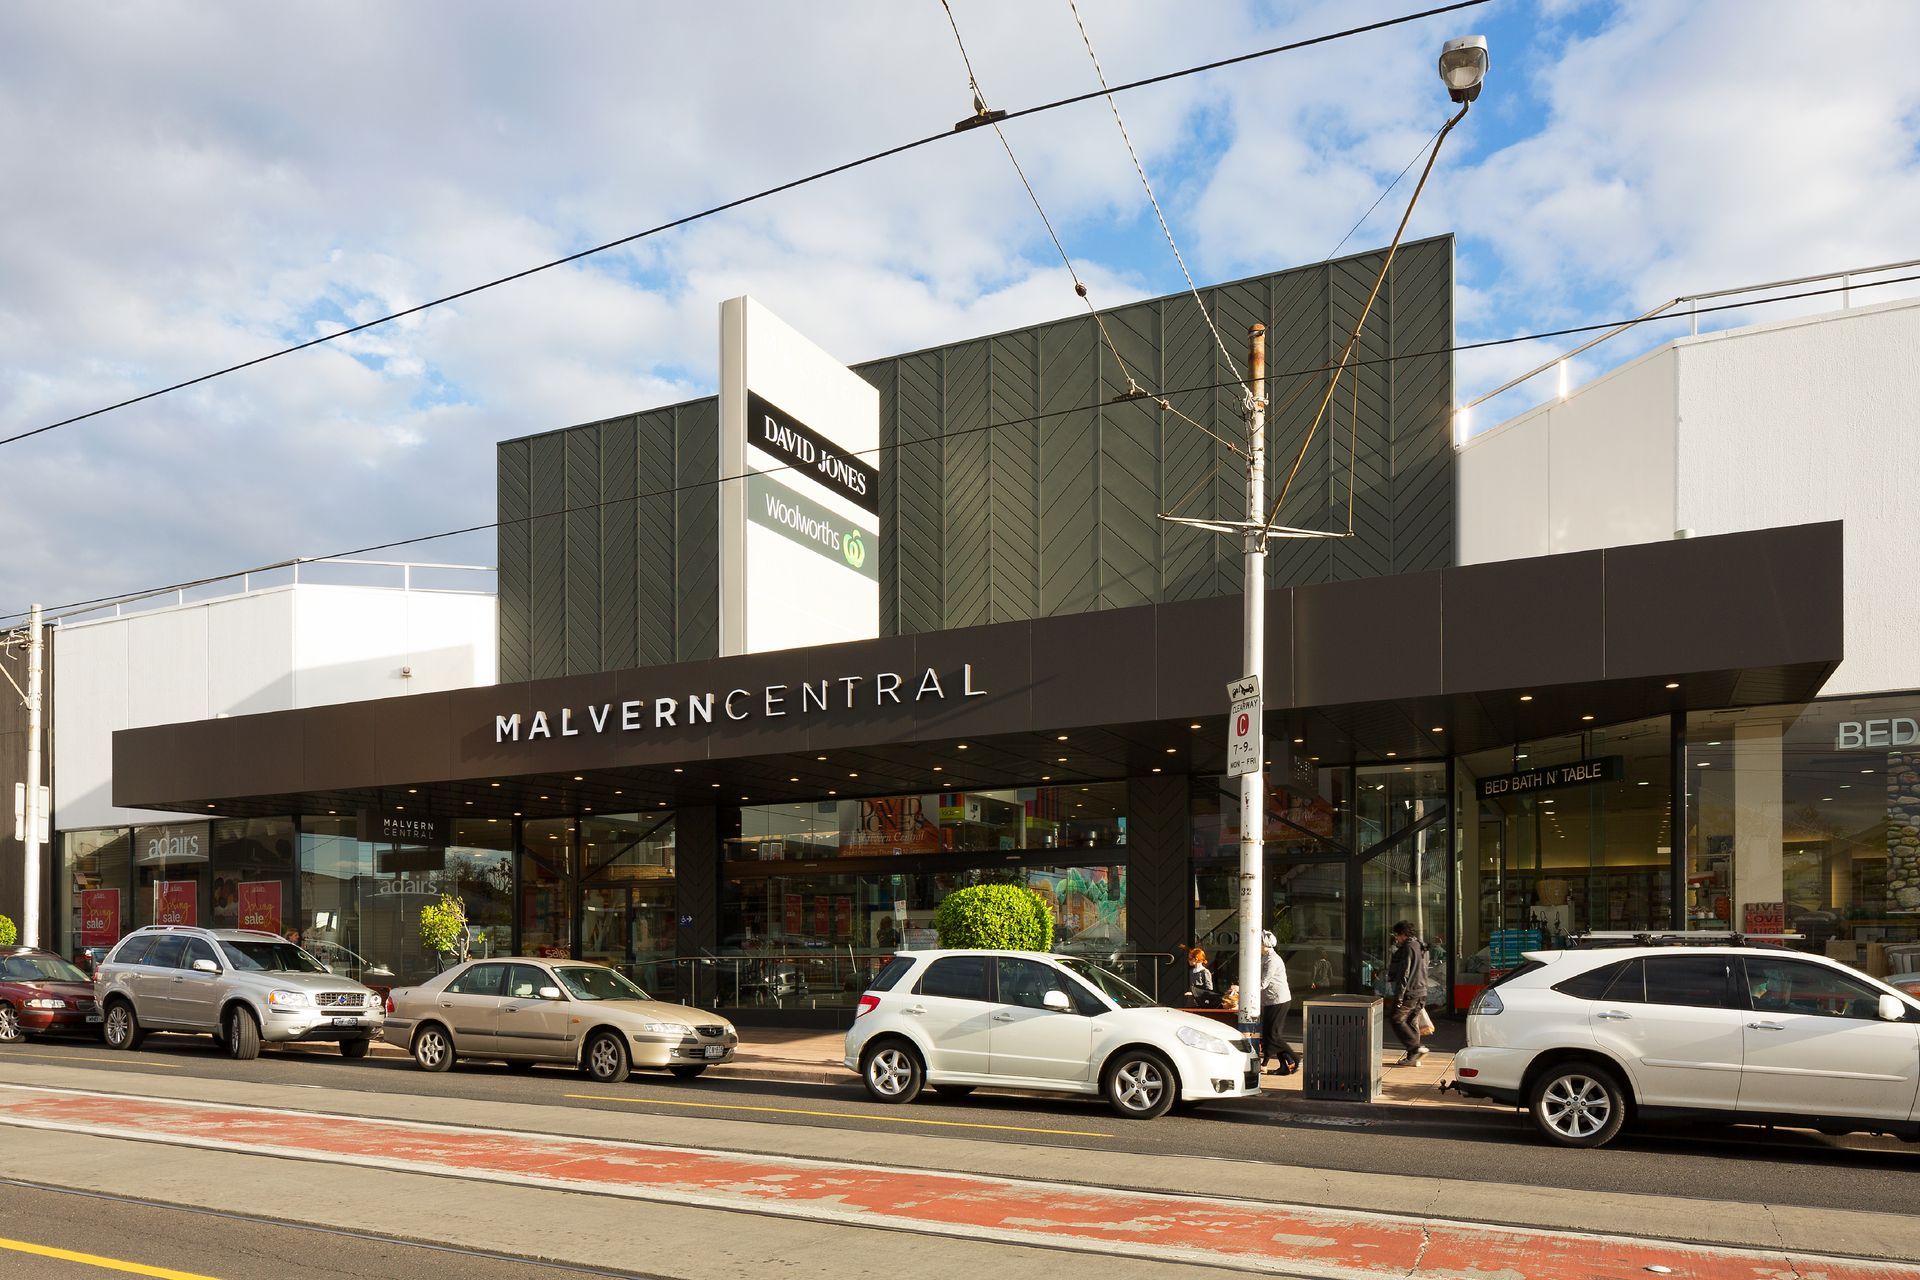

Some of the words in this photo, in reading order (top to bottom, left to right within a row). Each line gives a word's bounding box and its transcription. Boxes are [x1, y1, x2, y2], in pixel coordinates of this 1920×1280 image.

[764, 415, 815, 463] DAVID
[818, 450, 866, 495] JONES
[766, 493, 839, 550] Woolworths
[1233, 700, 1257, 714] CLEARWAY
[1839, 719, 1919, 748] BED
[1485, 779, 1508, 795] BED
[1512, 773, 1542, 790] BATH
[1561, 763, 1601, 782] TABLE
[384, 819, 433, 831] MALVERN
[384, 828, 433, 839] CENTRAL
[149, 829, 199, 858] adairs
[380, 875, 438, 895] adairs
[86, 918, 104, 929] sale
[162, 911, 181, 923] sale
[244, 913, 264, 925] sale
